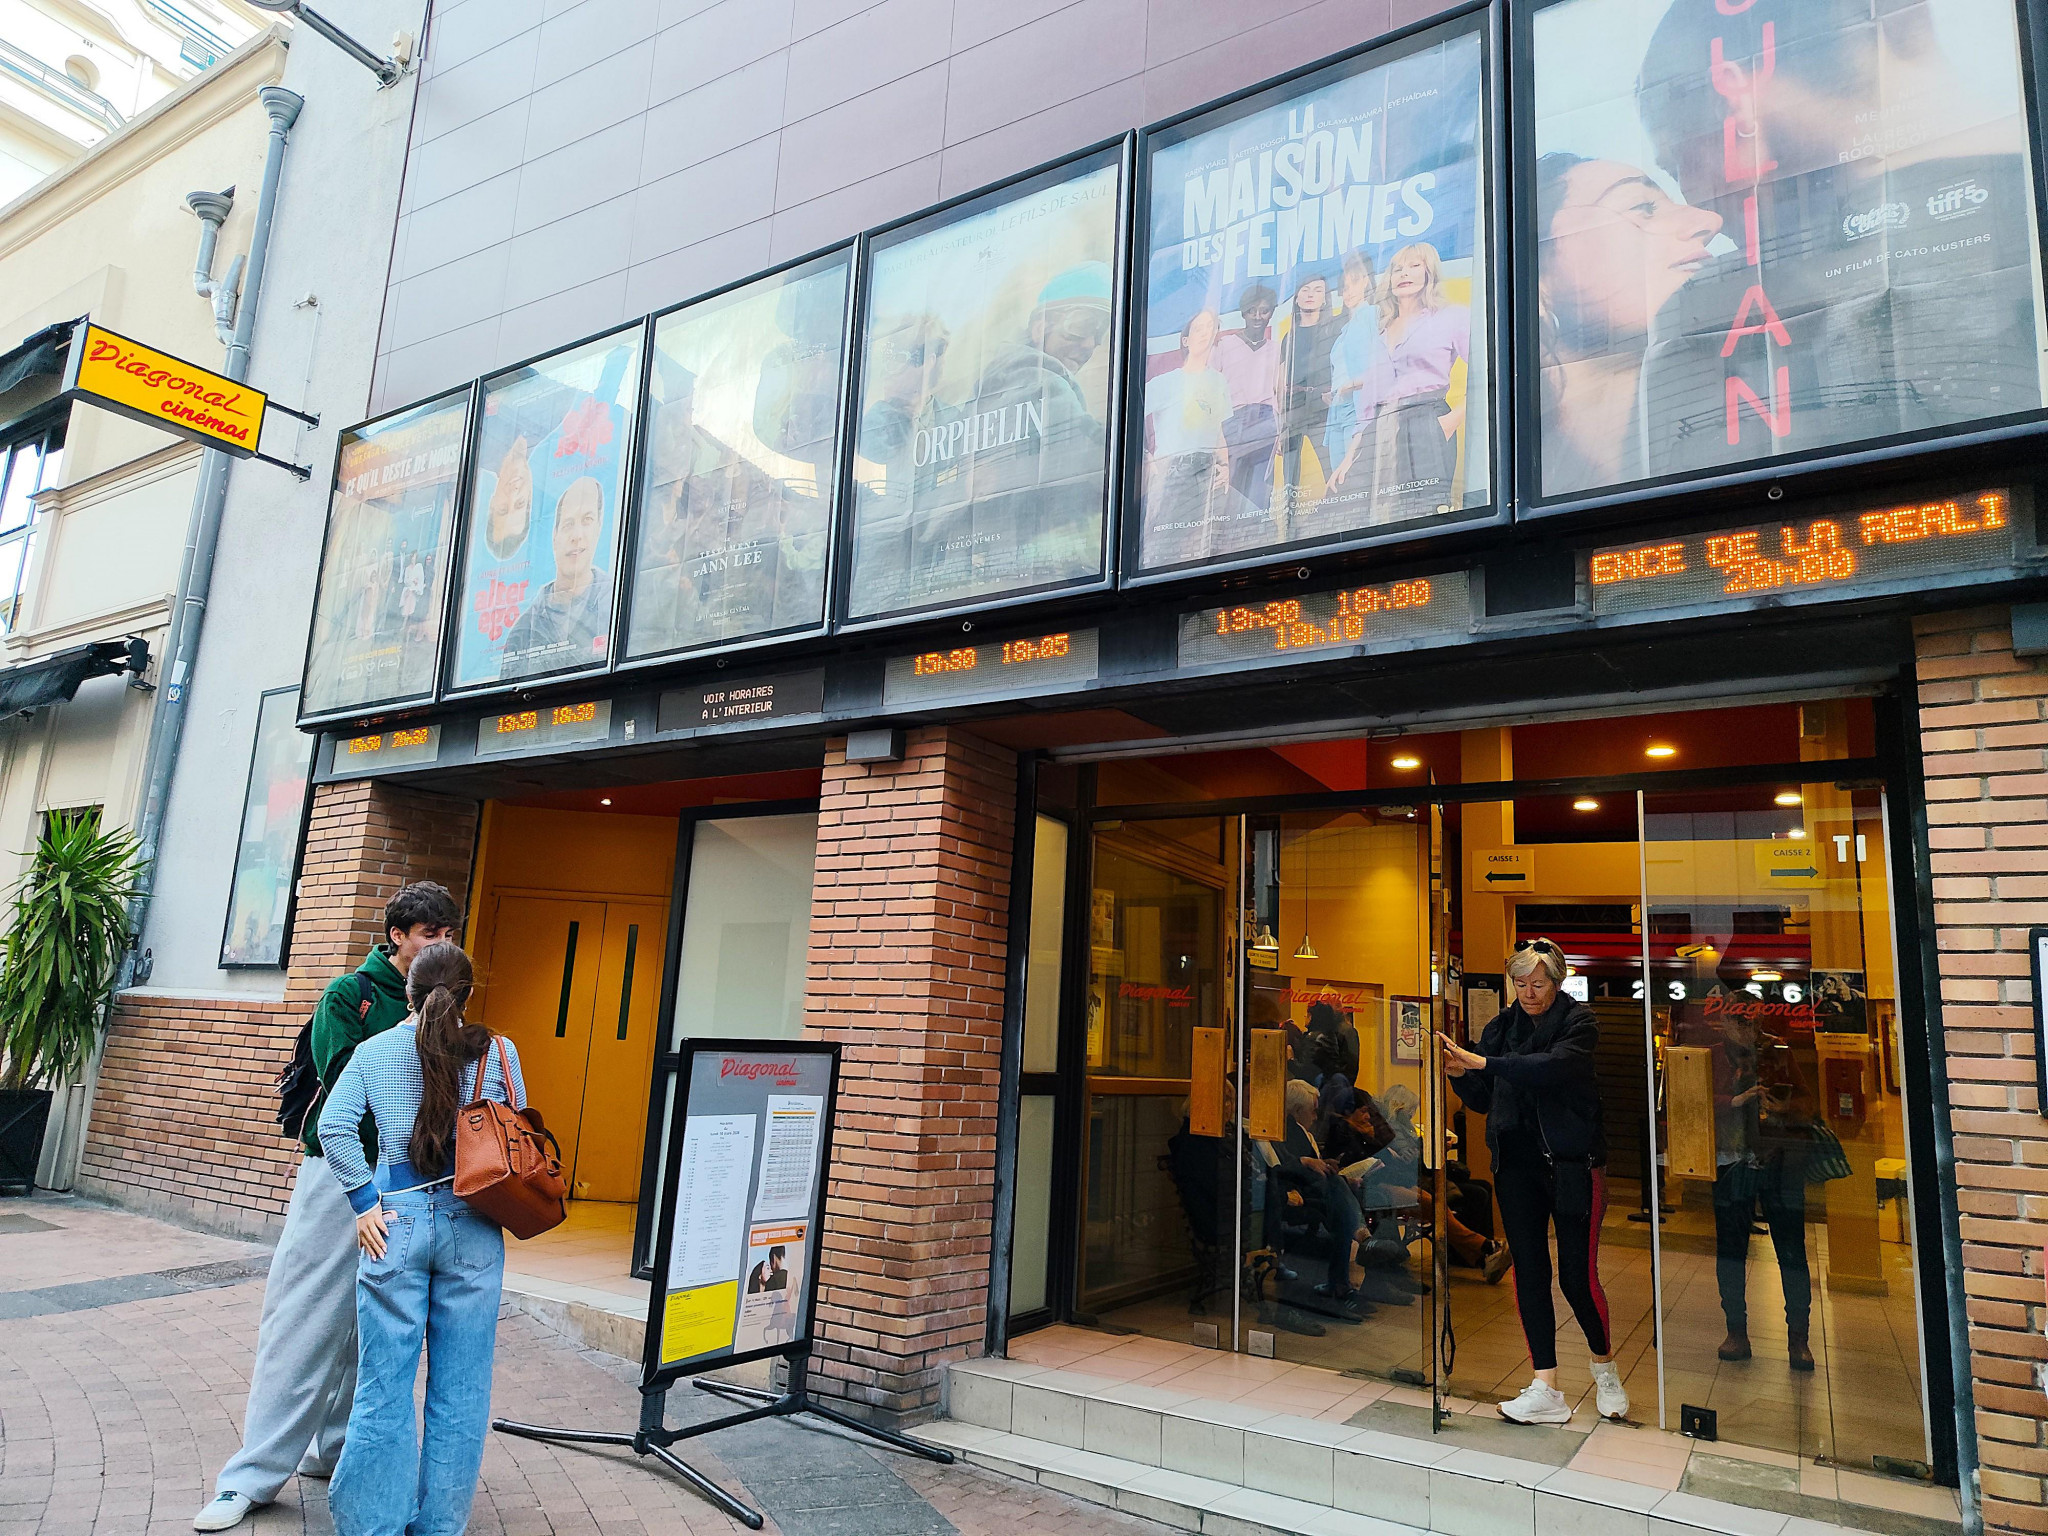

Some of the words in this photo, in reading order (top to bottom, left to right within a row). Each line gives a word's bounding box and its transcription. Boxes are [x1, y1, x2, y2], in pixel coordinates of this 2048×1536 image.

[1288, 103, 1315, 141] LA
[1317, 116, 1348, 130] OULAYA
[1205, 157, 1227, 171] VIARD
[1260, 135, 1287, 152] DOSCH
[1183, 121, 1373, 240] MAISON
[1182, 231, 1224, 271] DES
[1223, 172, 1436, 285] FEMMES
[1825, 265, 1842, 279] UN
[1845, 258, 1873, 274] FILM
[1876, 251, 1891, 264] DE
[1895, 247, 1928, 260] CATO
[1932, 233, 1992, 254] KUSTERS
[90, 339, 252, 418] Diagonal
[160, 398, 250, 443] cinémas
[912, 397, 1046, 468] ORPHELIN
[345, 477, 356, 498] CE
[382, 458, 412, 484] RESTE
[414, 452, 427, 474] DE
[428, 443, 460, 469] NOUS
[1375, 484, 1405, 497] LAURENT
[1405, 477, 1440, 491] STOCKER
[974, 532, 1001, 545] NEMES
[1153, 522, 1173, 533] PIERRE
[1591, 541, 1687, 585] ENCE
[1705, 530, 1761, 567] DE
[1780, 520, 1841, 555] LA
[1724, 548, 1855, 593] 20h00
[474, 579, 530, 612] alter
[1337, 579, 1431, 617] 18h00
[478, 605, 521, 641] ego
[1274, 614, 1364, 650] 18h10
[914, 646, 977, 677] 15h30
[1002, 632, 1070, 664] 18h05
[701, 708, 709, 720] A
[712, 701, 773, 718] L'INTERIEUR
[703, 692, 725, 705] VOIR
[729, 685, 774, 701] HORAIRES
[1488, 854, 1513, 863] CAISSE
[1773, 849, 1803, 858] CAISSE
[1805, 848, 1811, 857] 2
[1118, 983, 1196, 1001] Diagonal
[1279, 987, 1369, 1006] Diagonal
[1599, 981, 1610, 997] 1
[1631, 979, 1645, 999] 2
[1668, 980, 1686, 1000] 3
[1706, 984, 1724, 998] 4
[1783, 982, 1802, 1003] 6
[1703, 996, 1833, 1020] Diagonal
[720, 1057, 803, 1080] Diagonal
